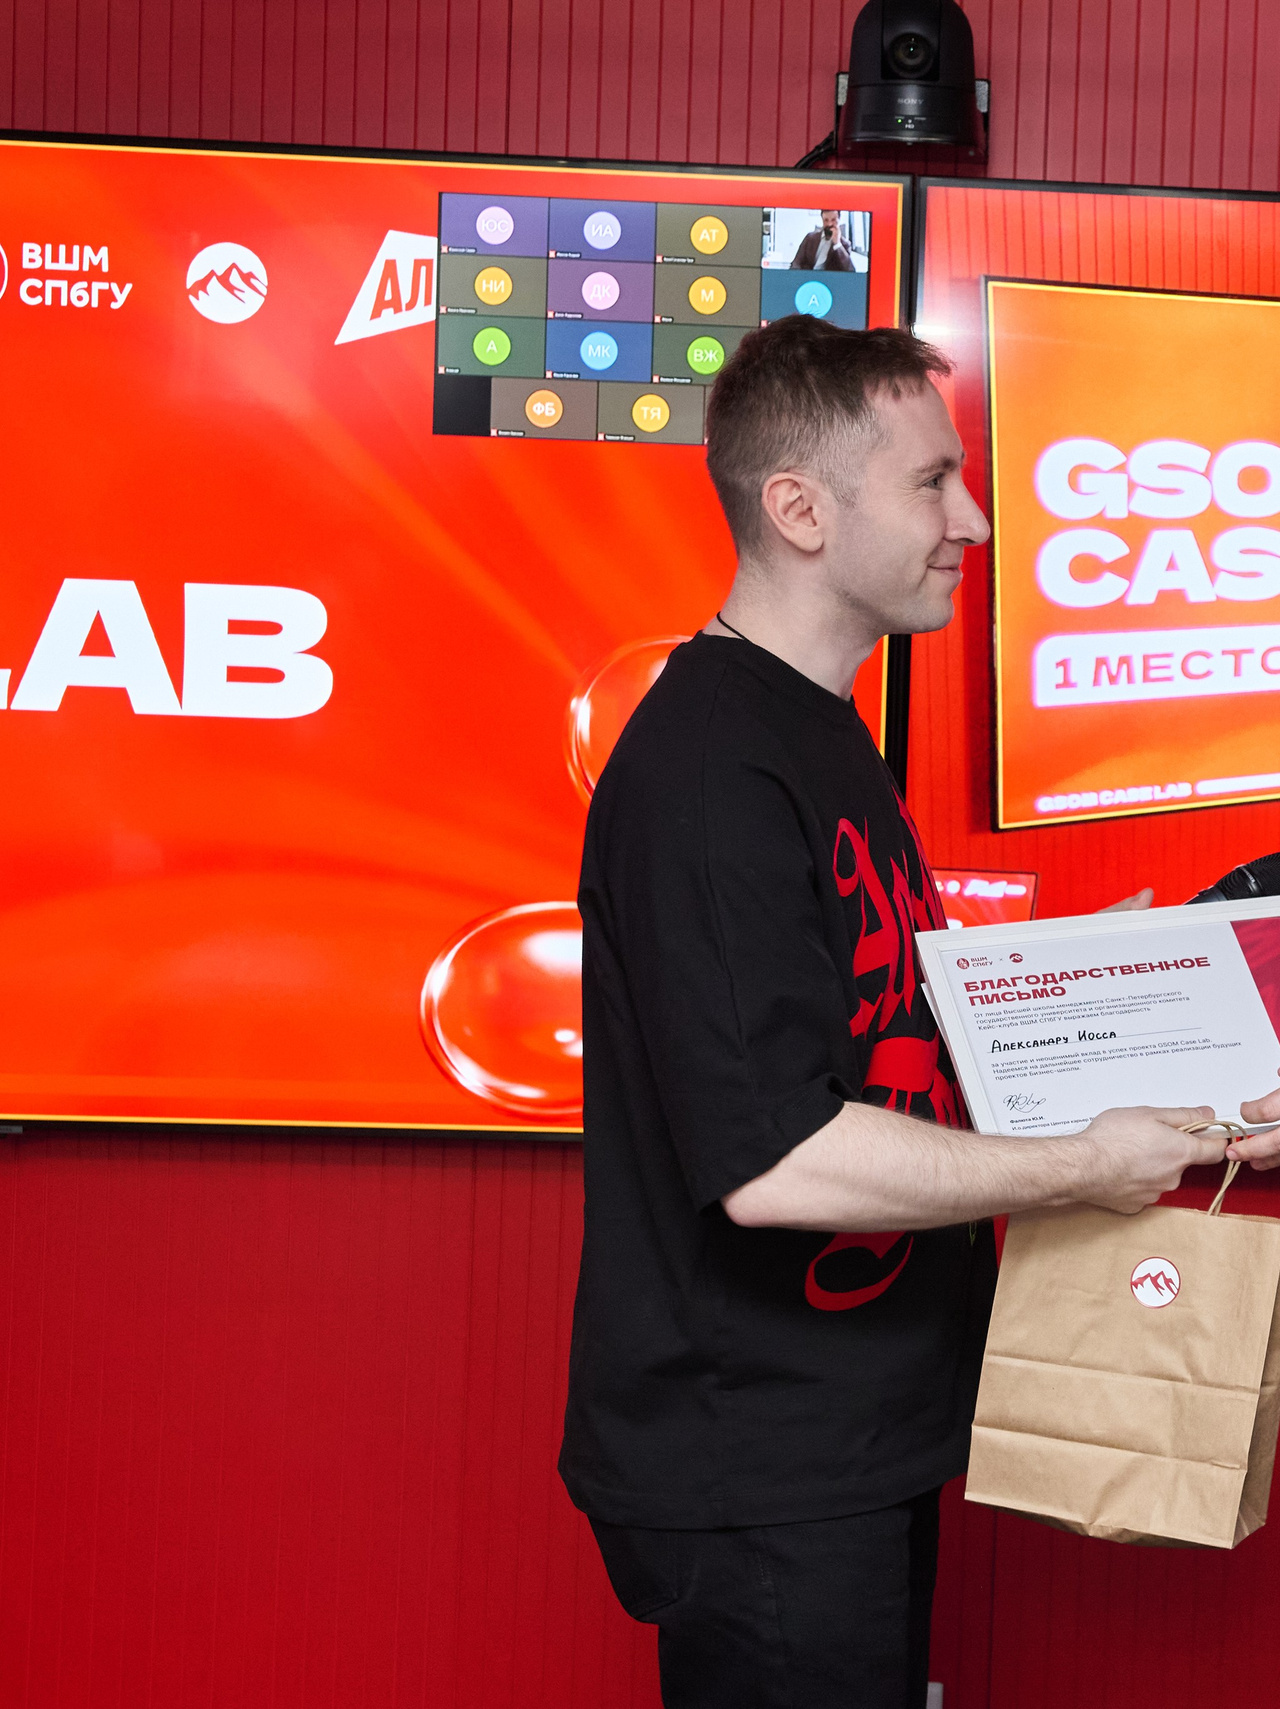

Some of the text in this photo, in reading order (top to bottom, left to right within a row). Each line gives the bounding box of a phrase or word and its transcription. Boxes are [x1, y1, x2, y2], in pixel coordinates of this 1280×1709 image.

[481, 219, 509, 233] ЮС
[592, 224, 614, 238] ИА
[699, 229, 718, 242] АТ
[22, 242, 108, 272] ВШМ
[19, 278, 133, 310] СПбГУ
[482, 279, 504, 294] НИ
[590, 284, 611, 300] ДК
[700, 289, 714, 302] М
[486, 340, 498, 352] А
[588, 345, 611, 358] МК
[694, 349, 719, 362] ВЖ
[532, 402, 556, 417] ФБ
[641, 406, 661, 420] ТЯ
[0, 577, 334, 719] AB
[1054, 658, 1078, 690] 1
[964, 956, 1210, 992] БЛАГОДАРСТВЕННОЕ
[968, 986, 1066, 1006] ПИСЬМО
[1003, 1006, 1031, 1015] Высшей
[1057, 999, 1104, 1010] менеджмента
[1105, 990, 1182, 1003] Санкт-Петербургского
[976, 1013, 1038, 1024] государственного
[1040, 1008, 1088, 1018] университета
[1095, 1000, 1158, 1011] организационного
[1159, 996, 1190, 1004] комитета
[978, 1022, 1018, 1031] Кейс-клуба
[1064, 1012, 1099, 1021] выражаем
[1100, 1007, 1151, 1017] благодарность
[993, 1065, 1028, 1074] Надеемся
[1040, 1059, 1081, 1069] дальнейшее
[1083, 1053, 1138, 1063] сотрудничество
[1171, 1045, 1211, 1054] реализации
[1000, 1060, 1028, 1068] участие
[1036, 1052, 1080, 1062] неоценимый
[1128, 1044, 1157, 1052] проекта
[995, 1072, 1028, 1081] проектов
